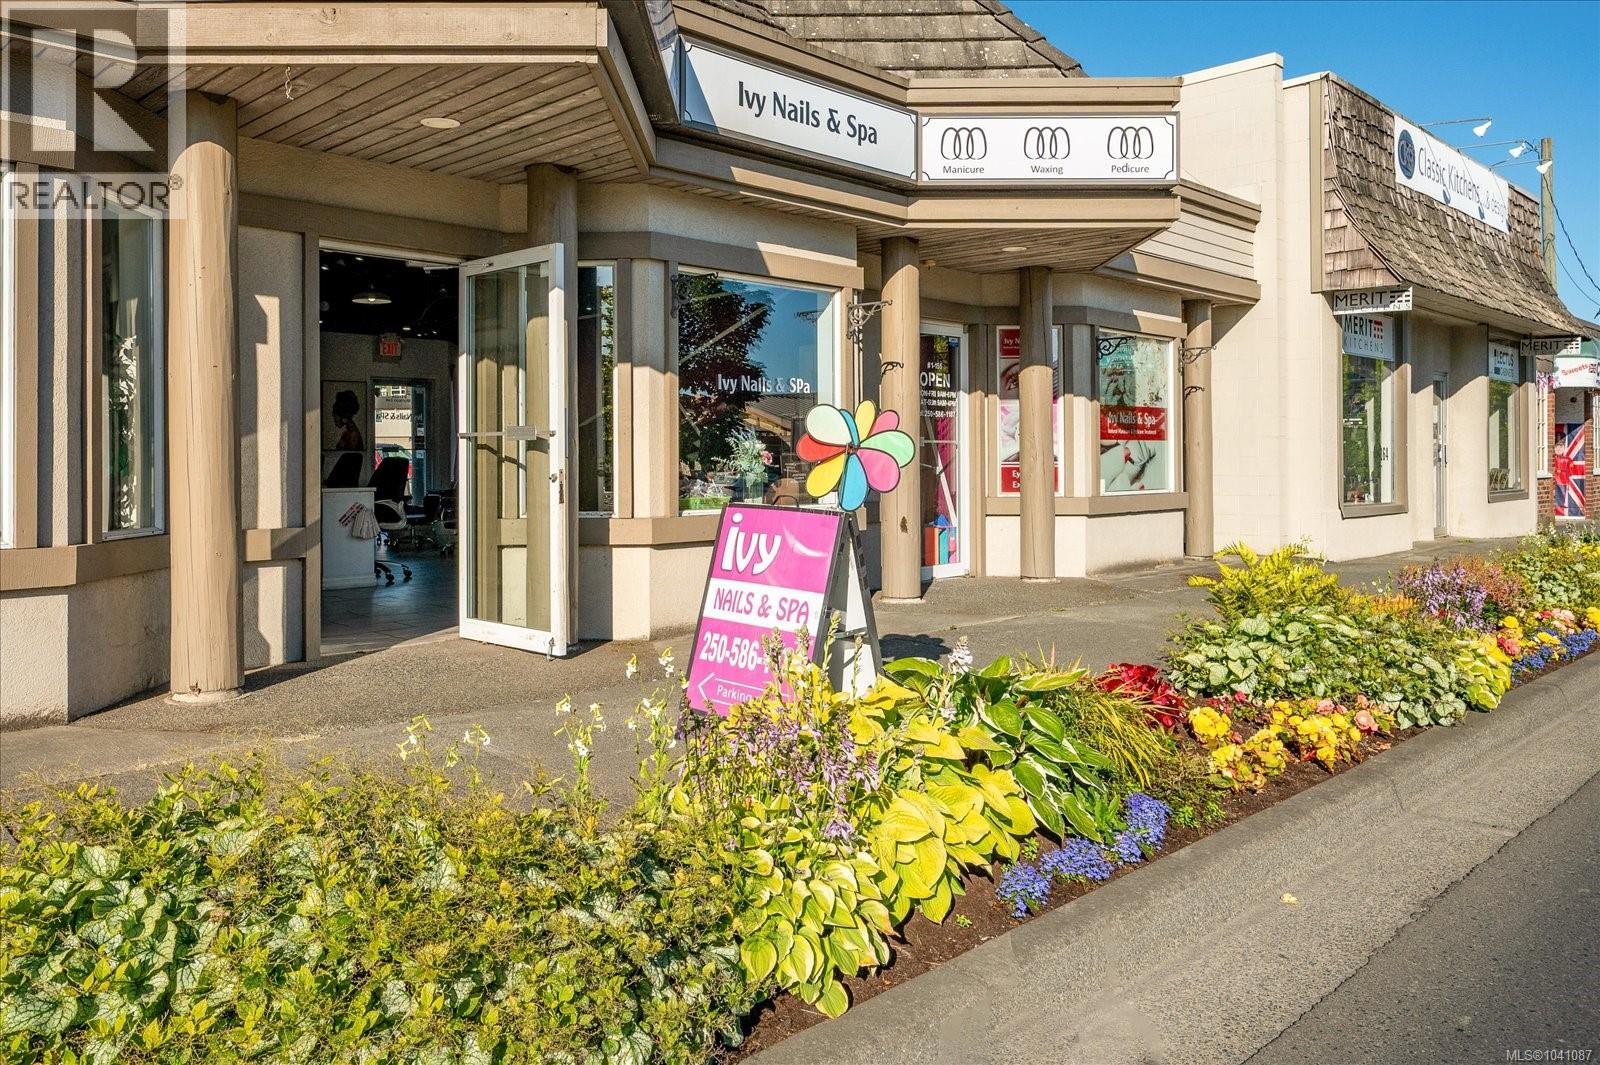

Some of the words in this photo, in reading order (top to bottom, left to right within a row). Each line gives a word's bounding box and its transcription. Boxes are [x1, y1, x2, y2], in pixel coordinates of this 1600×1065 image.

[738, 81, 766, 117] Ivy
[772, 91, 821, 129] Nails
[826, 108, 841, 134] &
[847, 114, 878, 146] Spa
[942, 164, 985, 174] Manicure
[1030, 164, 1064, 176] Waxing
[1111, 163, 1150, 174] Pedicure
[1418, 147, 1446, 187] Classic
[1448, 164, 1480, 204] Kitchens
[1335, 291, 1387, 307] MERIT
[1344, 314, 1373, 338] MERIT
[1344, 336, 1384, 354] KITCHENS
[1521, 340, 1562, 351] MERIT
[718, 374, 738, 392] Ivy
[741, 375, 772, 393] Nails
[776, 377, 786, 393] &
[920, 371, 951, 388] OPEN
[721, 512, 782, 575] ivy
[713, 588, 753, 618] NAILS
[757, 594, 772, 618] &
[776, 597, 809, 625] SPA
[716, 684, 752, 702] Parking
